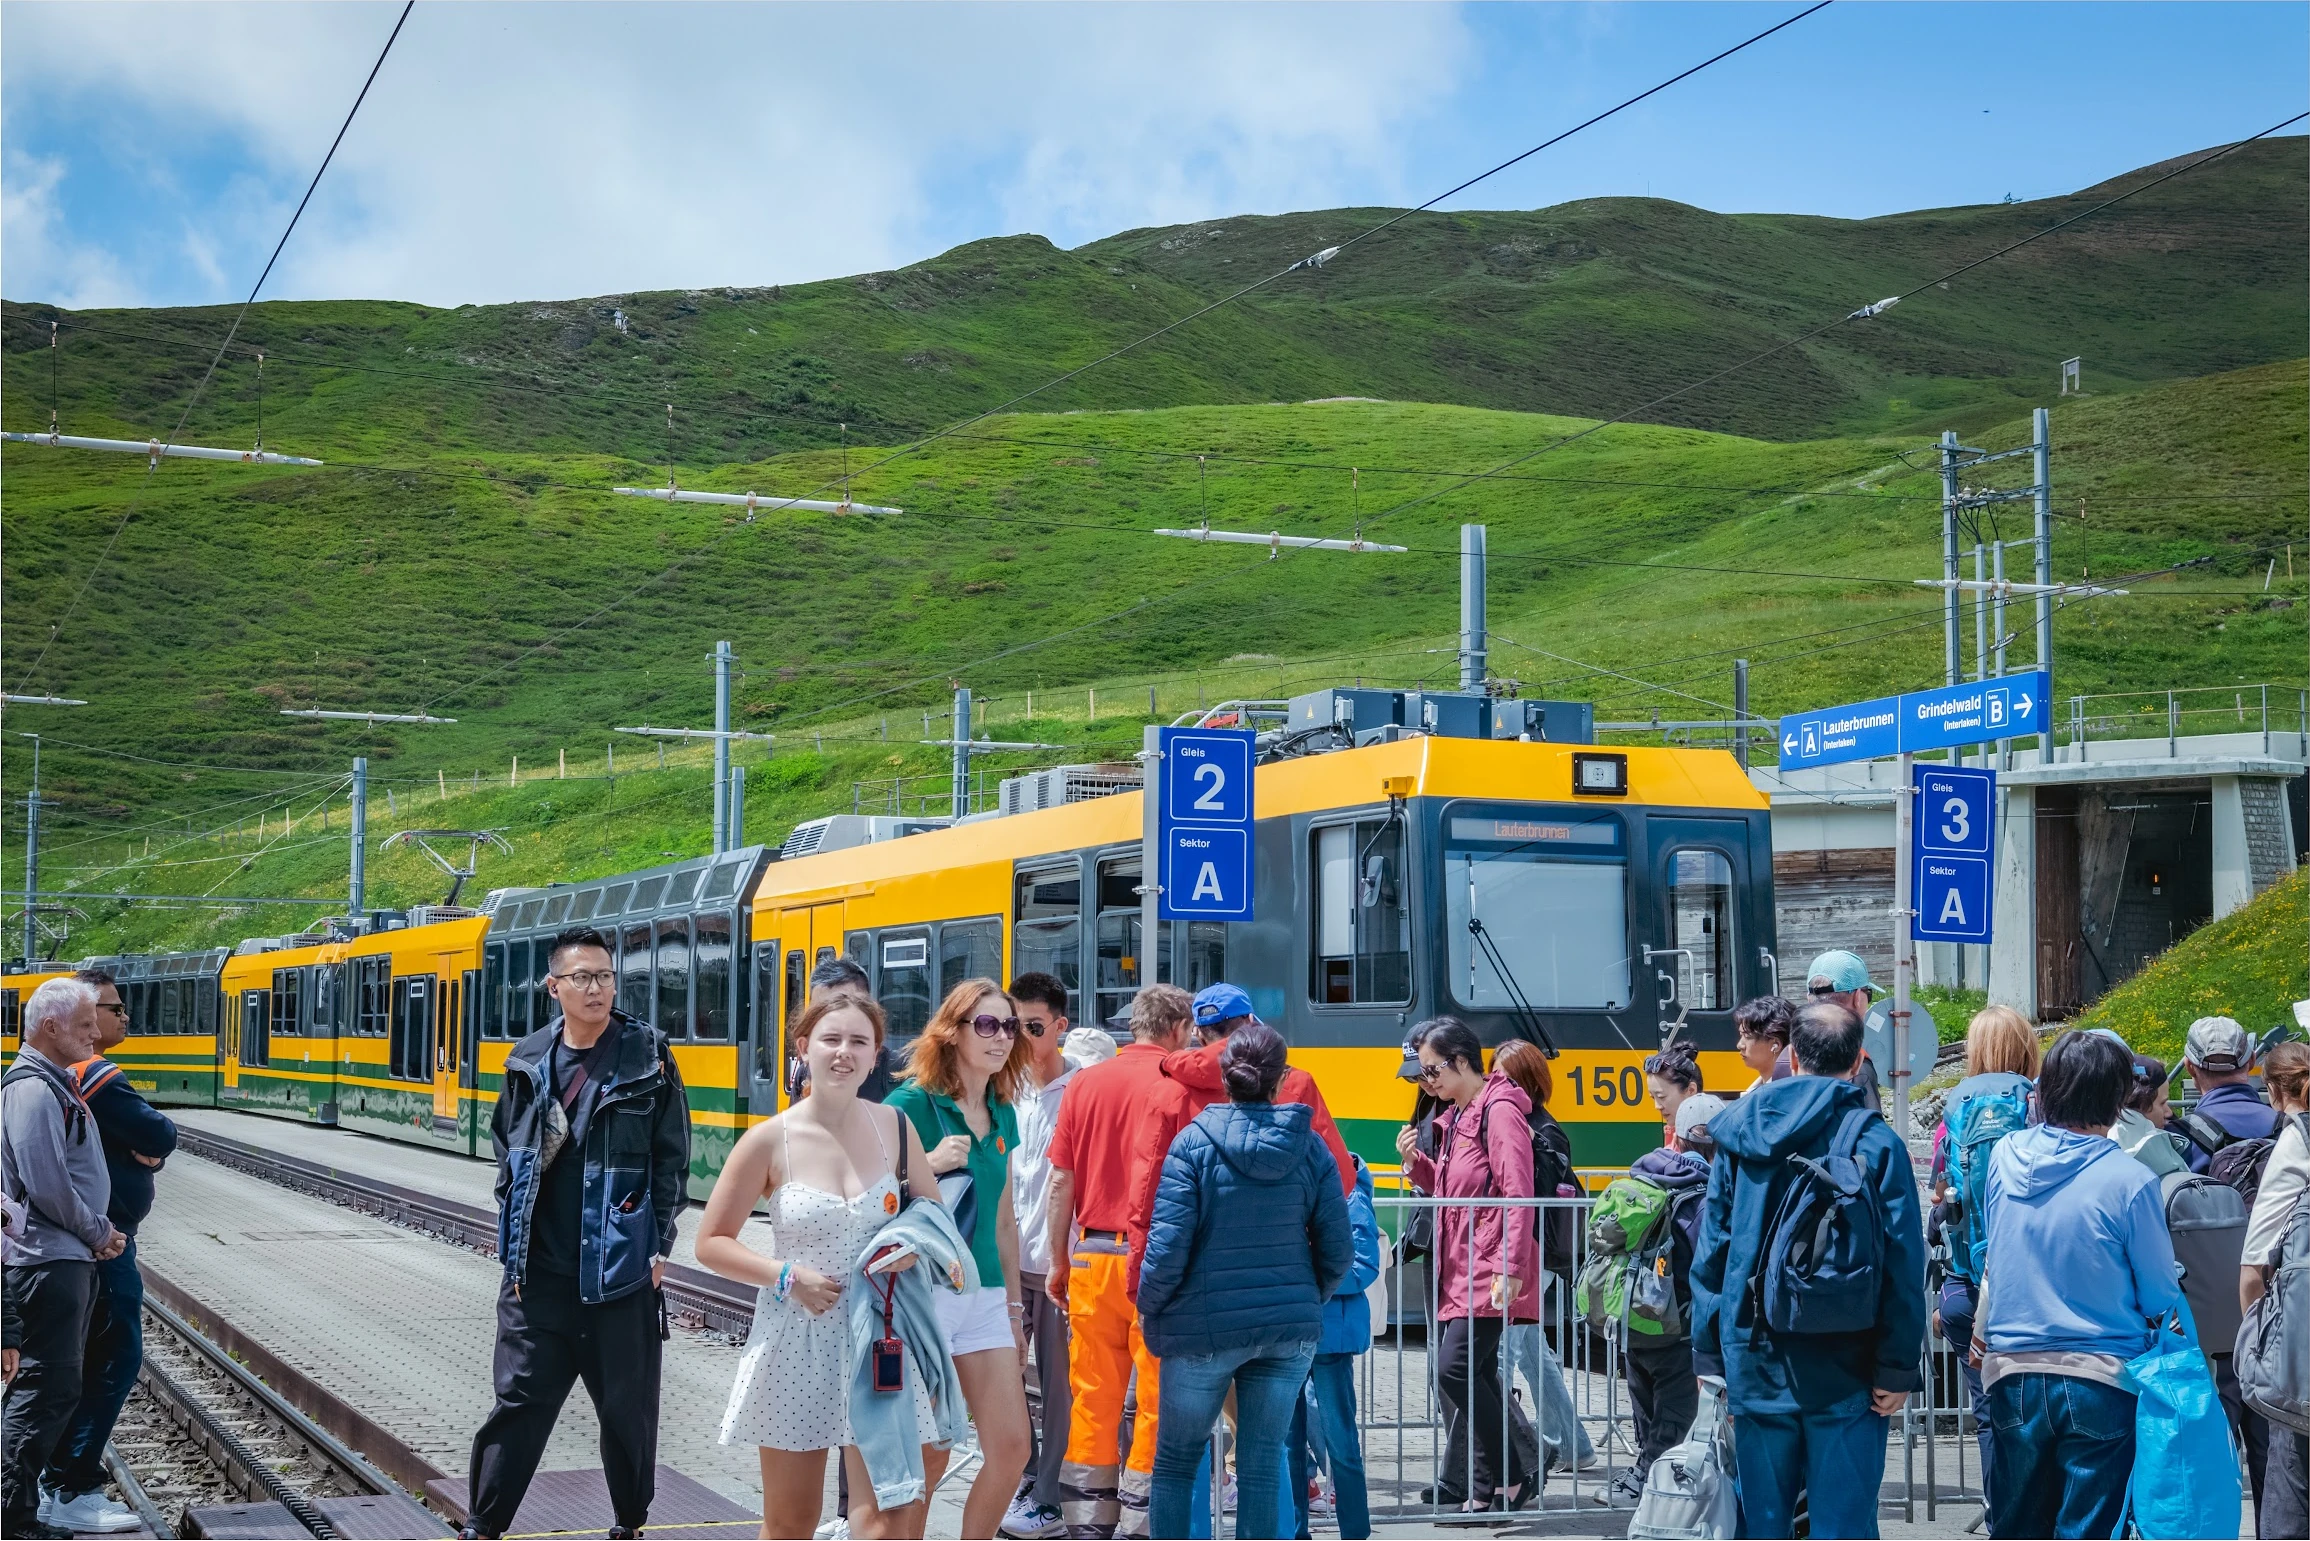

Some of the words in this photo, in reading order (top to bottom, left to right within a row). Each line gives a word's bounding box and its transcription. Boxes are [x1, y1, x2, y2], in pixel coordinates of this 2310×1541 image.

[1918, 694, 1982, 720] Grindelwald
[1991, 700, 2003, 723] B
[1823, 712, 1894, 736] Lauterbrunnen
[1943, 714, 1981, 732] (Interlaken)
[1180, 747, 1206, 758] Gleis
[1805, 732, 1817, 753] A
[1823, 735, 1856, 751] (Interlaken)
[1193, 763, 1226, 811] 2
[1932, 783, 1954, 793] Gleis
[1494, 820, 1570, 839] Lauterbrunnen
[1941, 797, 1970, 843] 3
[1179, 838, 1211, 849] Sektor
[1191, 861, 1224, 902] A
[1929, 866, 1957, 877] Sektor
[1938, 888, 1967, 925] A
[1566, 1065, 1644, 1107] 150
